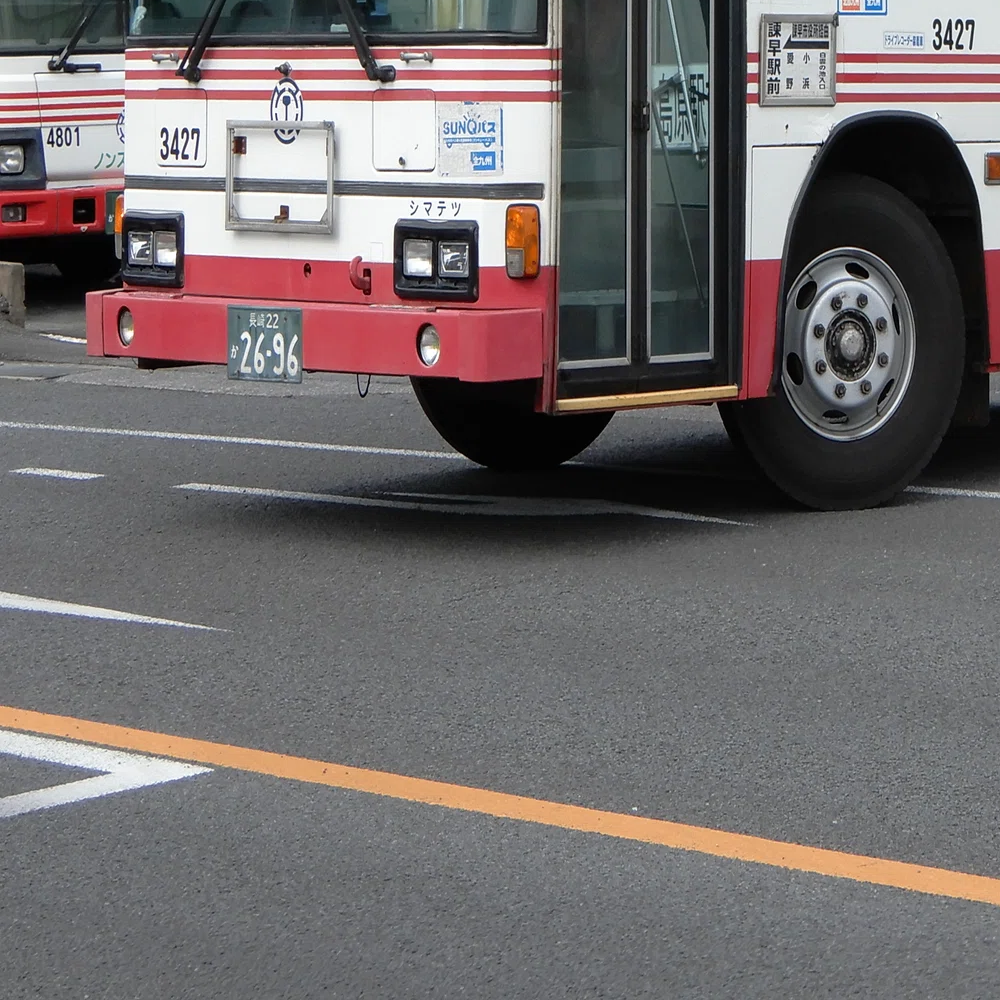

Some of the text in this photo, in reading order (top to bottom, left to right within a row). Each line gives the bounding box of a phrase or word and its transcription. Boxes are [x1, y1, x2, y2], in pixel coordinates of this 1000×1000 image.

[932, 18, 975, 51] 3427
[767, 22, 782, 95] 諫早駅前
[47, 126, 80, 148] 4801
[443, 119, 496, 135] SUNQパス
[160, 127, 200, 161] 3427
[410, 200, 461, 217] シマテツ
